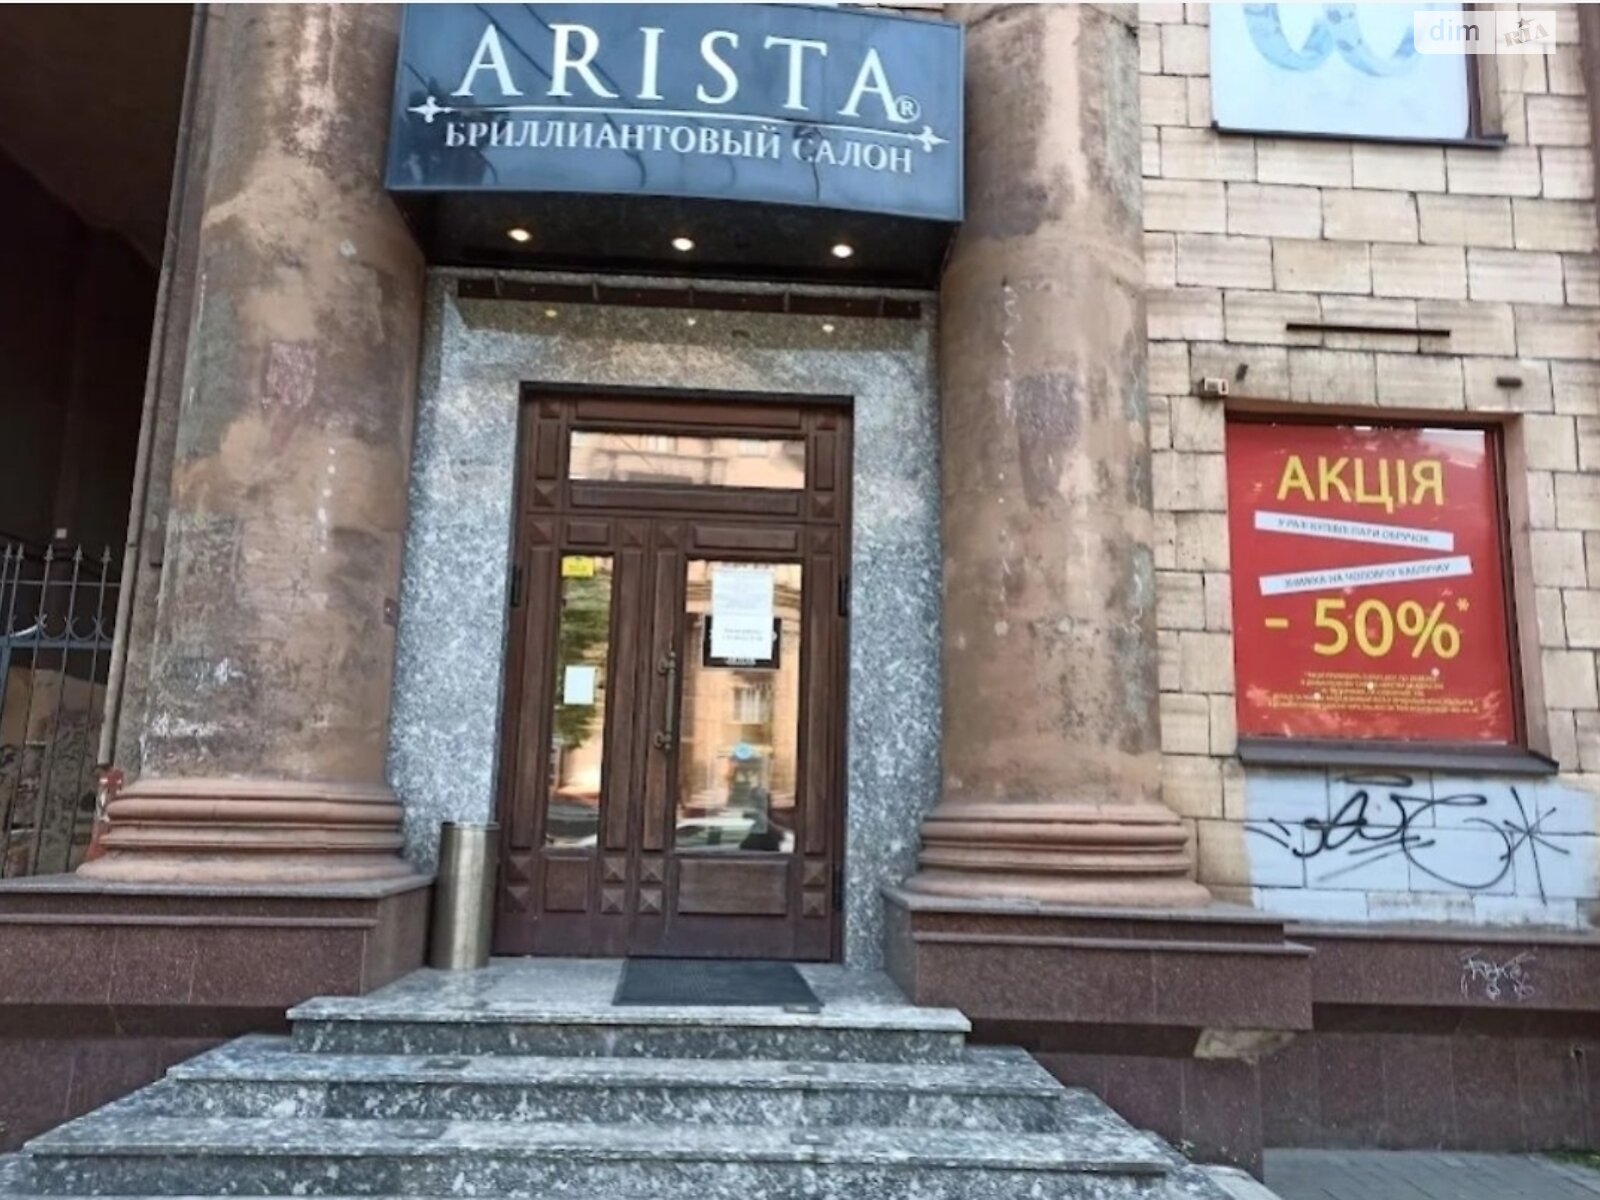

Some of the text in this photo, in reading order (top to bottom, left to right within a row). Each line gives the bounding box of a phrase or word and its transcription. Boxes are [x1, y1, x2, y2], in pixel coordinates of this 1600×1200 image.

[445, 121, 913, 174] БРИЛЛИАНТОВЫЙ САЛОН
[1276, 454, 1445, 514] АКЦІЯ
